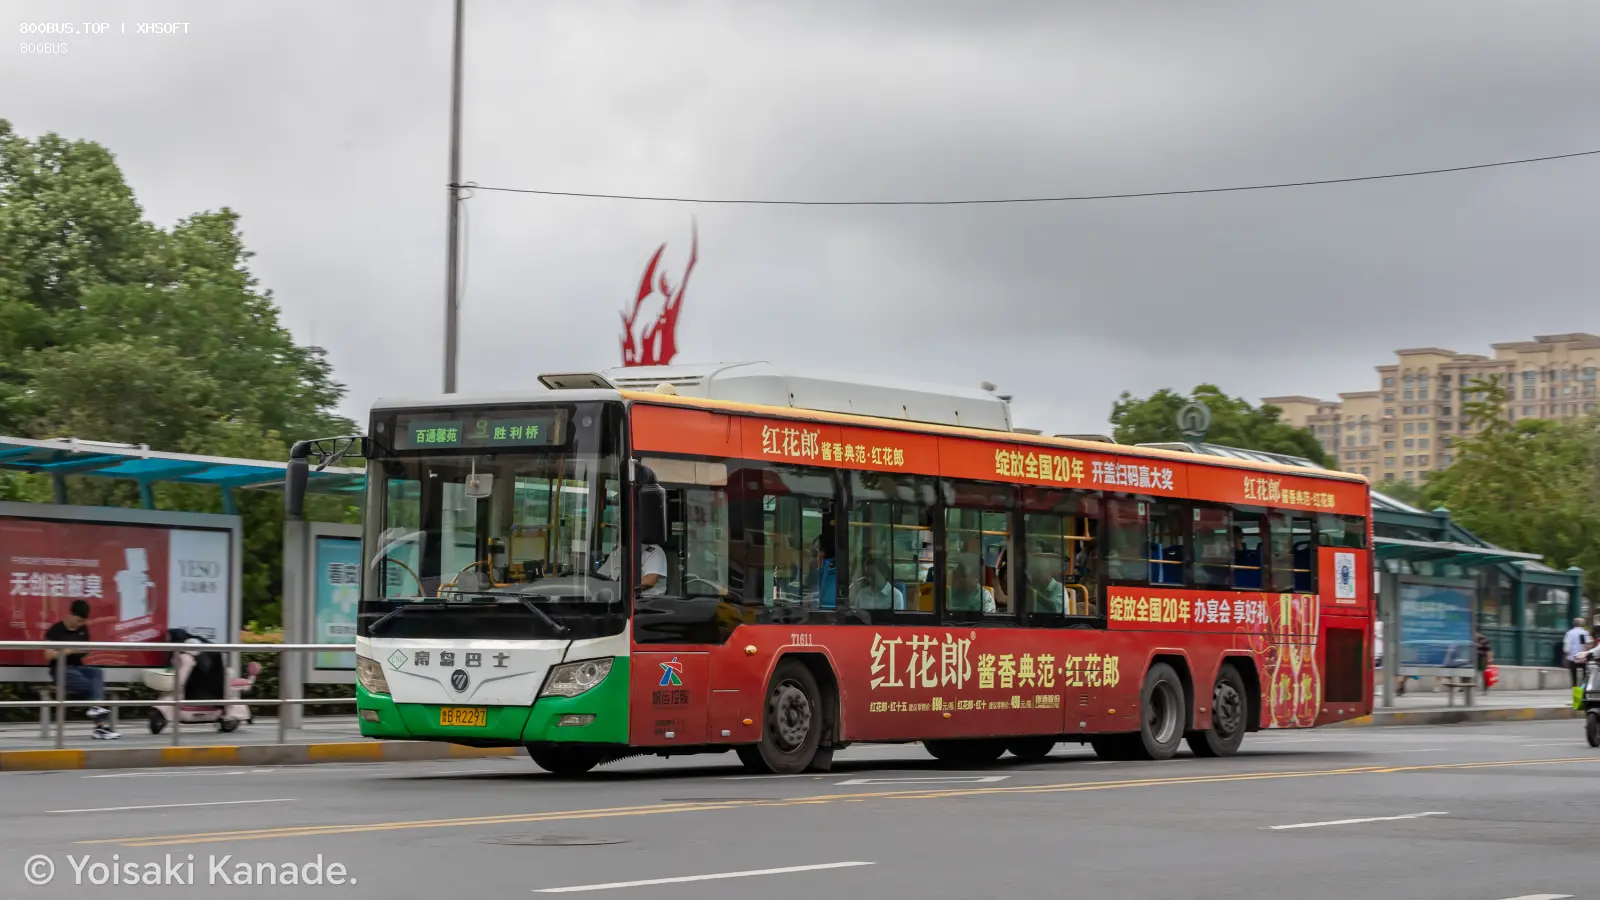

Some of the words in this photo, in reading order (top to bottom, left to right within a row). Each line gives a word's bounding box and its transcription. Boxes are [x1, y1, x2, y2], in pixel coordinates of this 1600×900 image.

[415, 428, 458, 444] 百通馨苑
[493, 425, 539, 440] 胜利桥
[761, 424, 819, 460] 红花郎
[995, 448, 1085, 485] 绽放全国20年
[1091, 461, 1175, 491] 开盖扫码赢大奖
[1243, 475, 1281, 503] 红花郎
[1109, 595, 1192, 624] 绽放全国20年
[1193, 598, 1232, 624] 办宴会
[1233, 599, 1269, 625] 享好礼
[791, 633, 813, 647] T1611
[870, 632, 973, 690] 红花郎
[977, 653, 1120, 688] 酱香典范·红花郎
